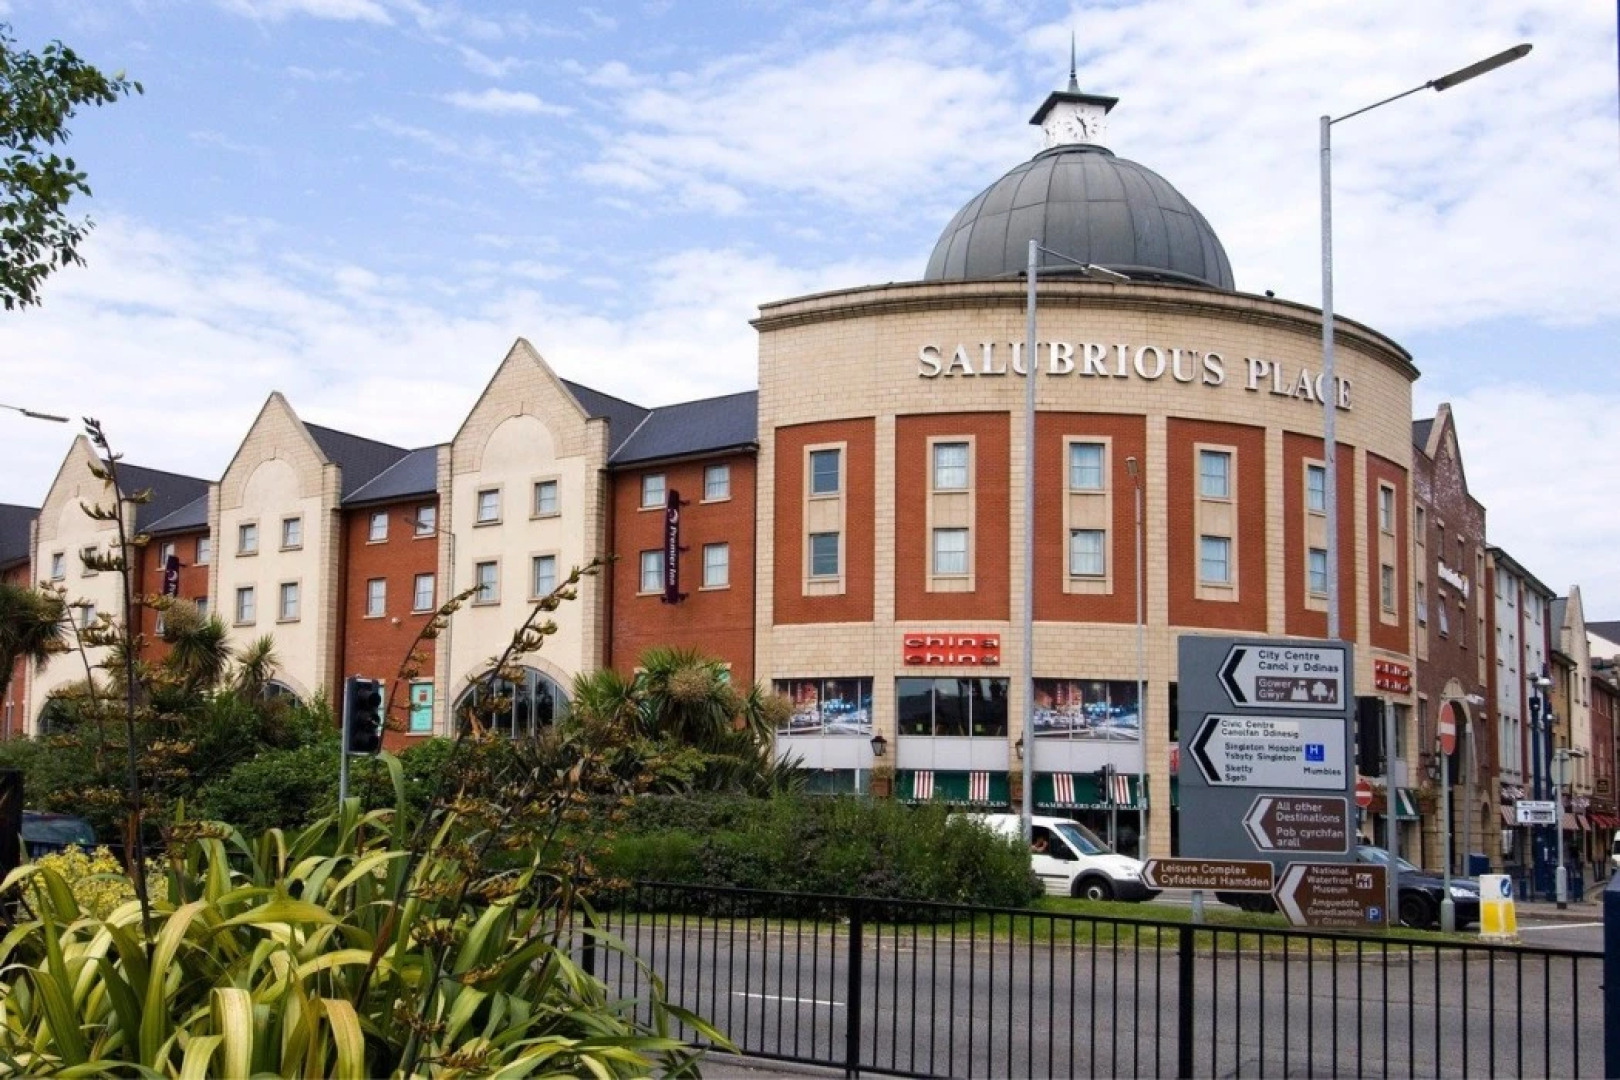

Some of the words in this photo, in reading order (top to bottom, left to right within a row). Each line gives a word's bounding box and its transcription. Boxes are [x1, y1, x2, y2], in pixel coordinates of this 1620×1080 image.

[917, 341, 1225, 387] SALUBRIOUS
[1258, 650, 1280, 661] City
[1284, 651, 1320, 661] Centre
[1258, 661, 1289, 671] Canol
[1293, 664, 1299, 673] y
[1303, 663, 1339, 673] Ddinas
[1245, 721, 1275, 729] Centre
[1303, 767, 1342, 776] Mumbles
[1276, 801, 1291, 811] All
[1295, 802, 1322, 812] other
[1276, 811, 1340, 823] Destinations
[1276, 827, 1297, 837] Pob
[1161, 863, 1198, 874] Leisure
[1201, 864, 1247, 875] Complex
[1312, 866, 1349, 875] National
[1220, 875, 1270, 887] Hamdden
[1313, 885, 1348, 894] Museum
[1369, 908, 1379, 919] P
